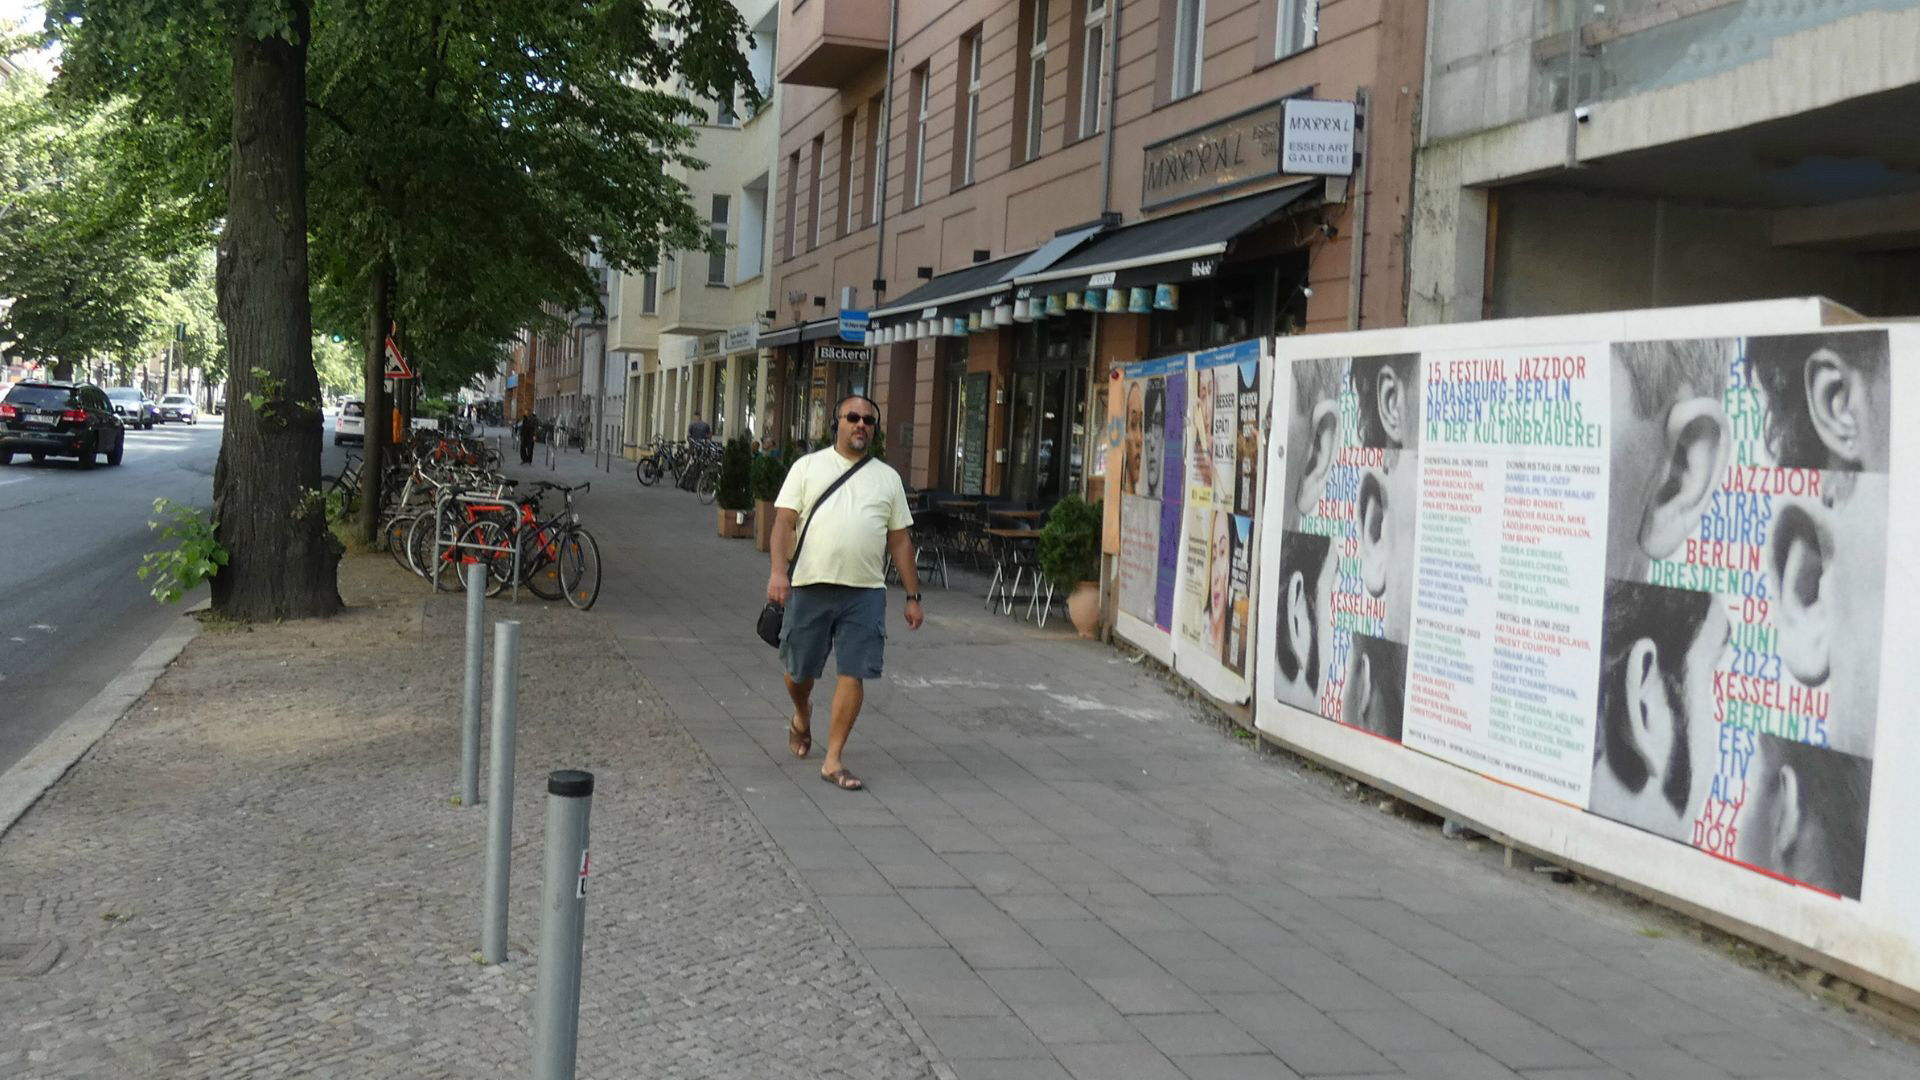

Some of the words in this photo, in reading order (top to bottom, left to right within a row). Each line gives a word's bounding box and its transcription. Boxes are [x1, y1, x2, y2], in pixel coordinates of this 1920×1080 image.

[1288, 153, 1348, 164] GALERIE
[821, 347, 870, 360] Bäckerei
[1450, 359, 1507, 383] FESTIVAL
[1515, 356, 1586, 380] JAZZDOR
[1426, 400, 1482, 422] DRESDEN
[1489, 401, 1582, 424] KESSELHAUS
[1724, 387, 1760, 414] FES
[1426, 421, 1438, 441] IN
[1444, 421, 1467, 442] DER
[1474, 422, 1602, 448] KULTURBRAUEREI
[1731, 413, 1762, 440] TIV
[1336, 447, 1383, 467] JAZZDOR
[1738, 440, 1759, 466] AL
[1331, 464, 1360, 484] STRAS
[1722, 465, 1820, 497] JAZZDOR
[1326, 482, 1357, 503] BOURG
[1711, 489, 1772, 521] STRAS
[1318, 499, 1354, 521] BERLIN
[1301, 515, 1344, 538] DRESDEN
[1701, 515, 1766, 546] BOURG
[1686, 538, 1760, 572] BERLIN
[1651, 559, 1739, 594] DRESDEN
[1534, 618, 1550, 629] JUNI
[1552, 622, 1570, 633] 2023
[1730, 622, 1779, 653] JUNI
[1731, 648, 1782, 681] 2023
[1714, 670, 1829, 719] KESSELHAU
[1727, 700, 1800, 742] BERLIN
[1693, 820, 1737, 858] DOR
